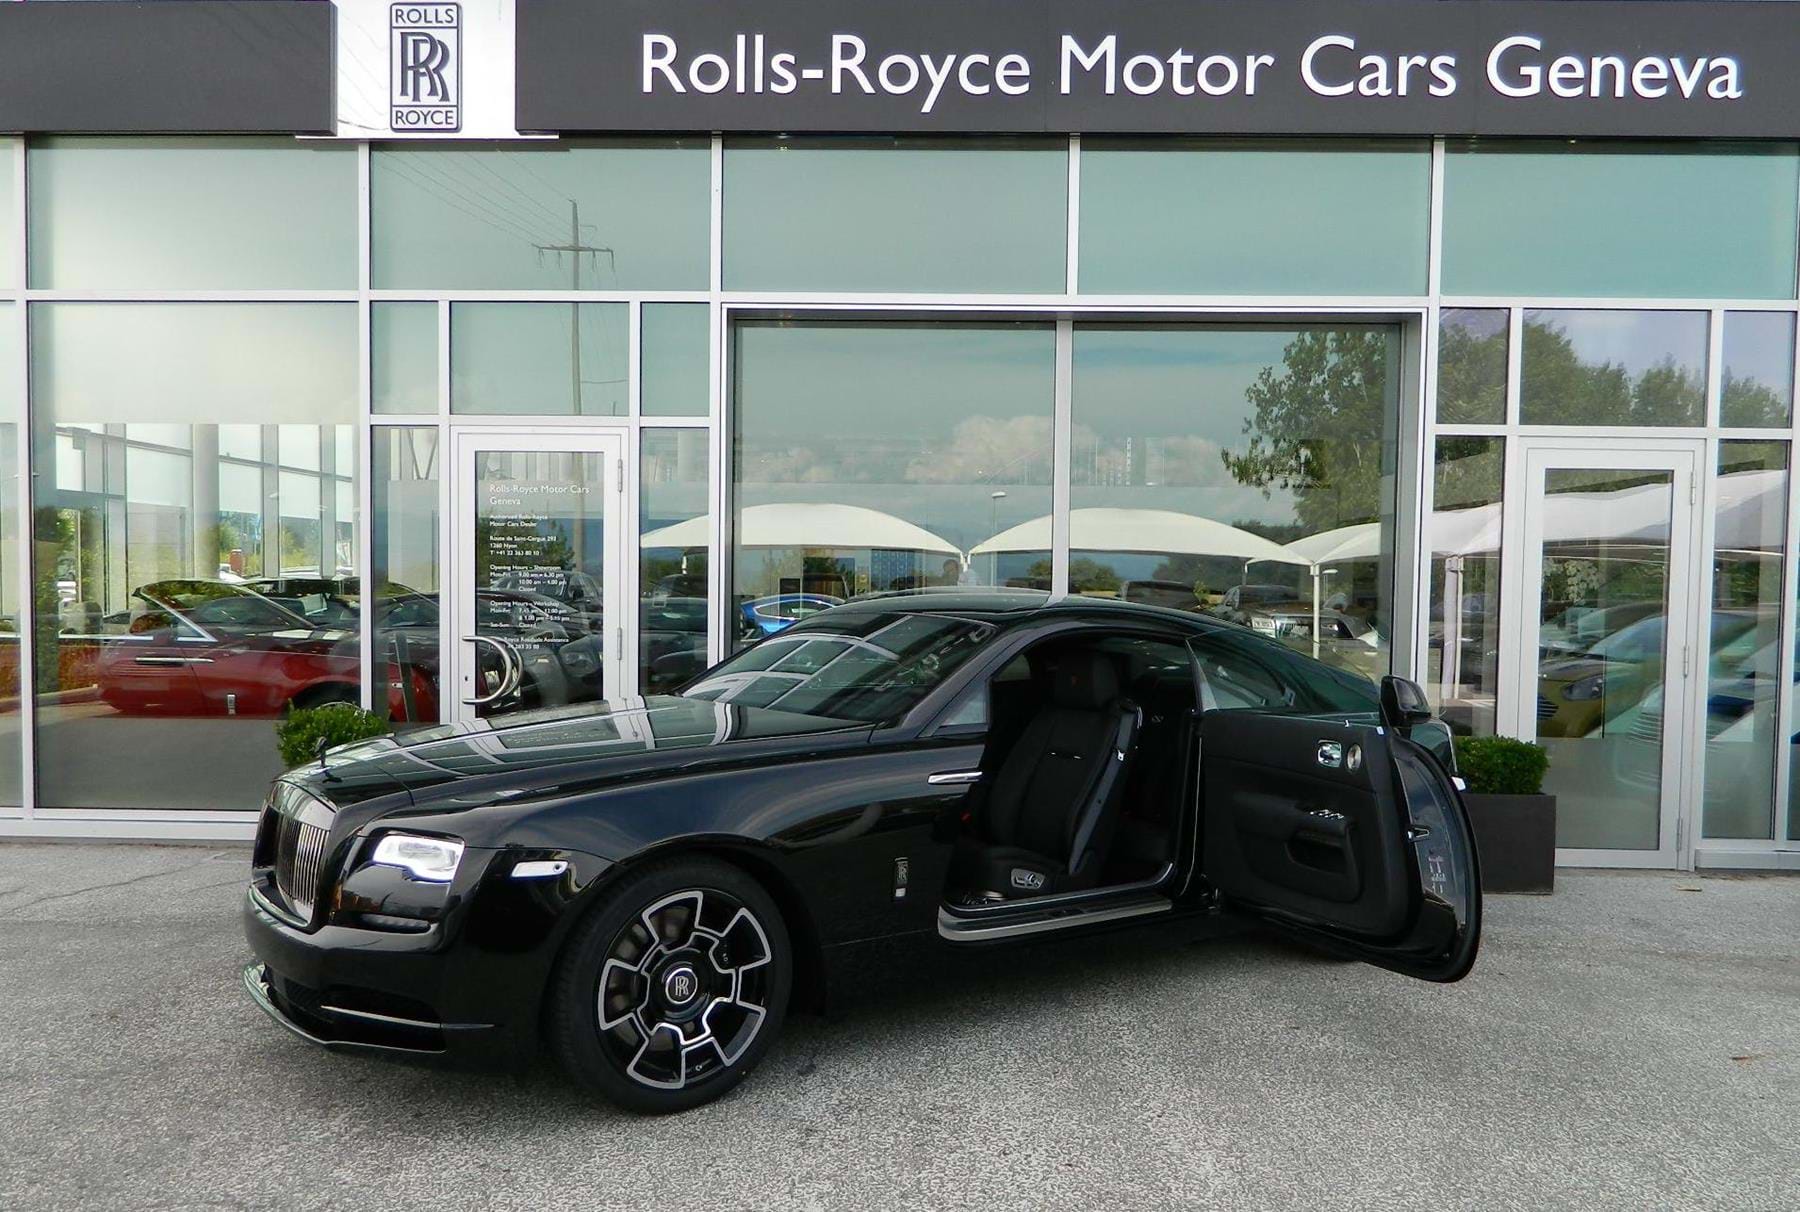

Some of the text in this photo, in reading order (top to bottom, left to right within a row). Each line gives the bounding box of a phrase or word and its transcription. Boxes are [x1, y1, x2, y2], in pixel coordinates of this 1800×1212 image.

[395, 8, 454, 24] ROLLS
[642, 34, 1743, 113] Rolls-Royce Motor Cars Geneva
[395, 110, 454, 125] ROYCE
[489, 484, 590, 495] Rolls-Royce Motor Cars
[489, 496, 521, 505] Geneva
